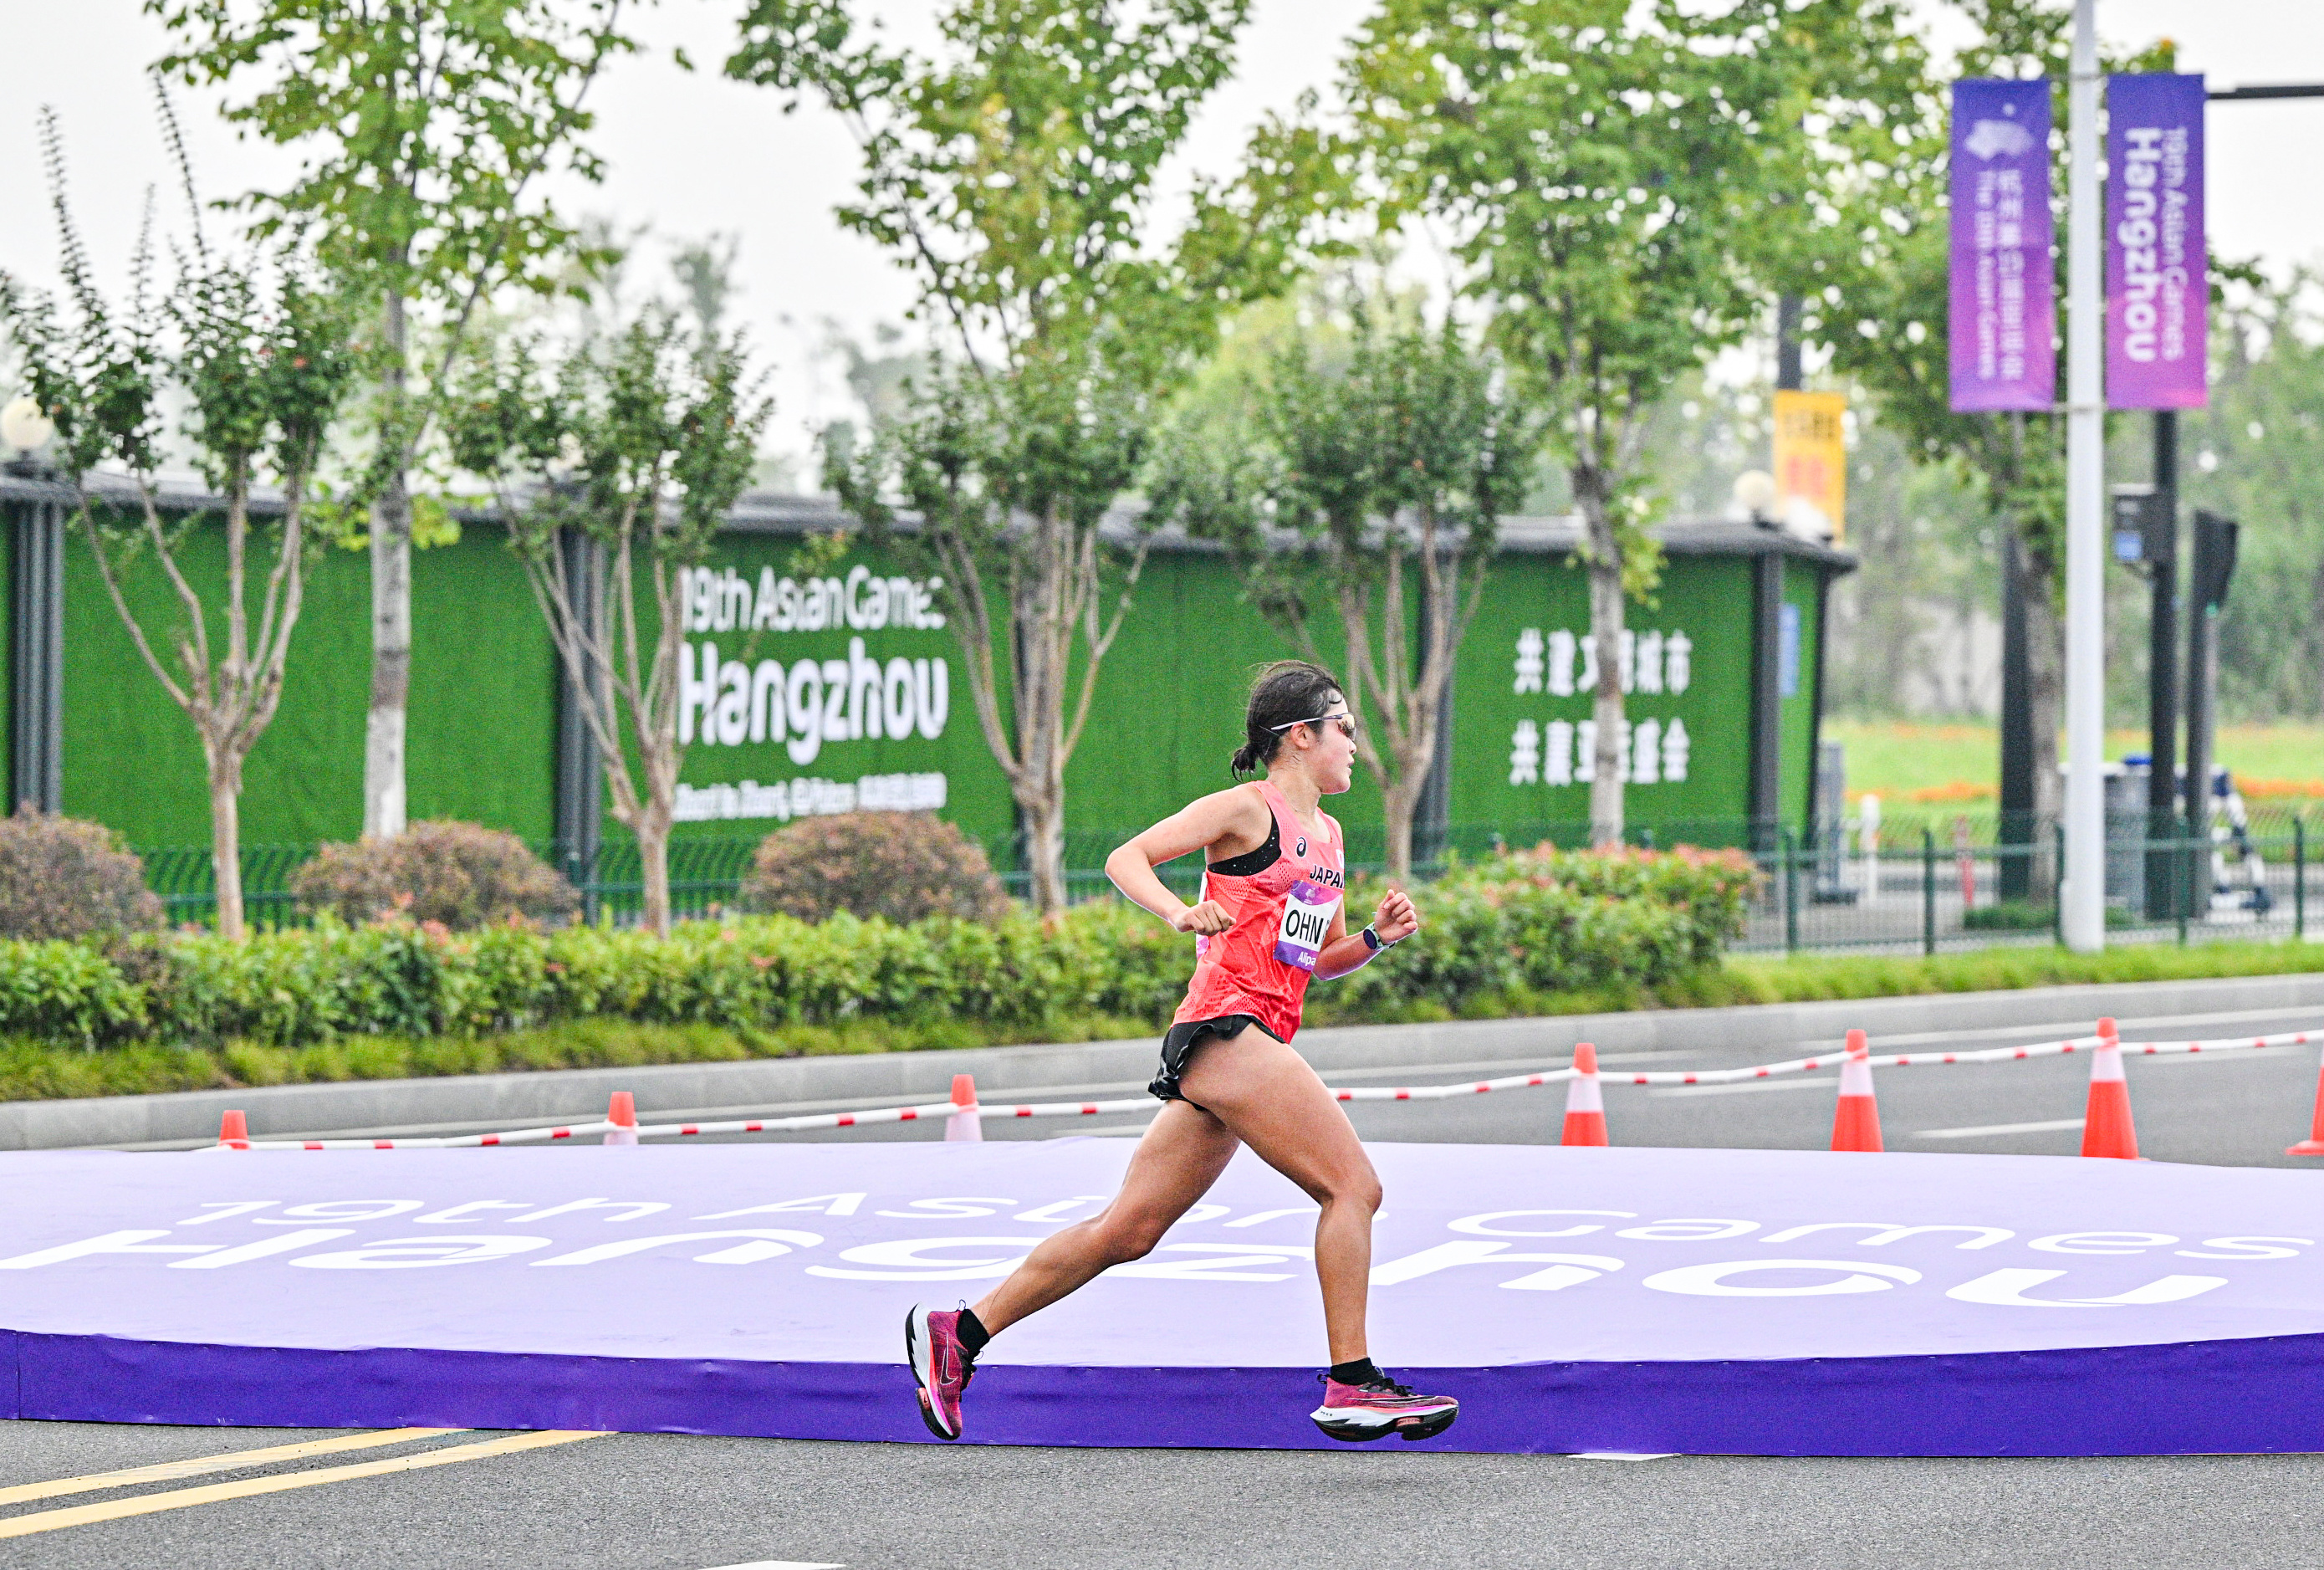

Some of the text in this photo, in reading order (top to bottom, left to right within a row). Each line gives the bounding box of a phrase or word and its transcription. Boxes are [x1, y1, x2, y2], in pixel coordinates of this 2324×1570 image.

[2117, 127, 2163, 362] Hangzhou
[2162, 189, 2189, 266] Asian
[2161, 266, 2189, 361] Games
[679, 564, 752, 632] 19th
[752, 564, 844, 632] Asian
[678, 637, 949, 765] Hangzhou
[1285, 909, 1330, 945] OHN
[176, 1196, 673, 1225] 19th
[1447, 1209, 2316, 1260] Games
[0, 1228, 2230, 1307] Hangzhou
